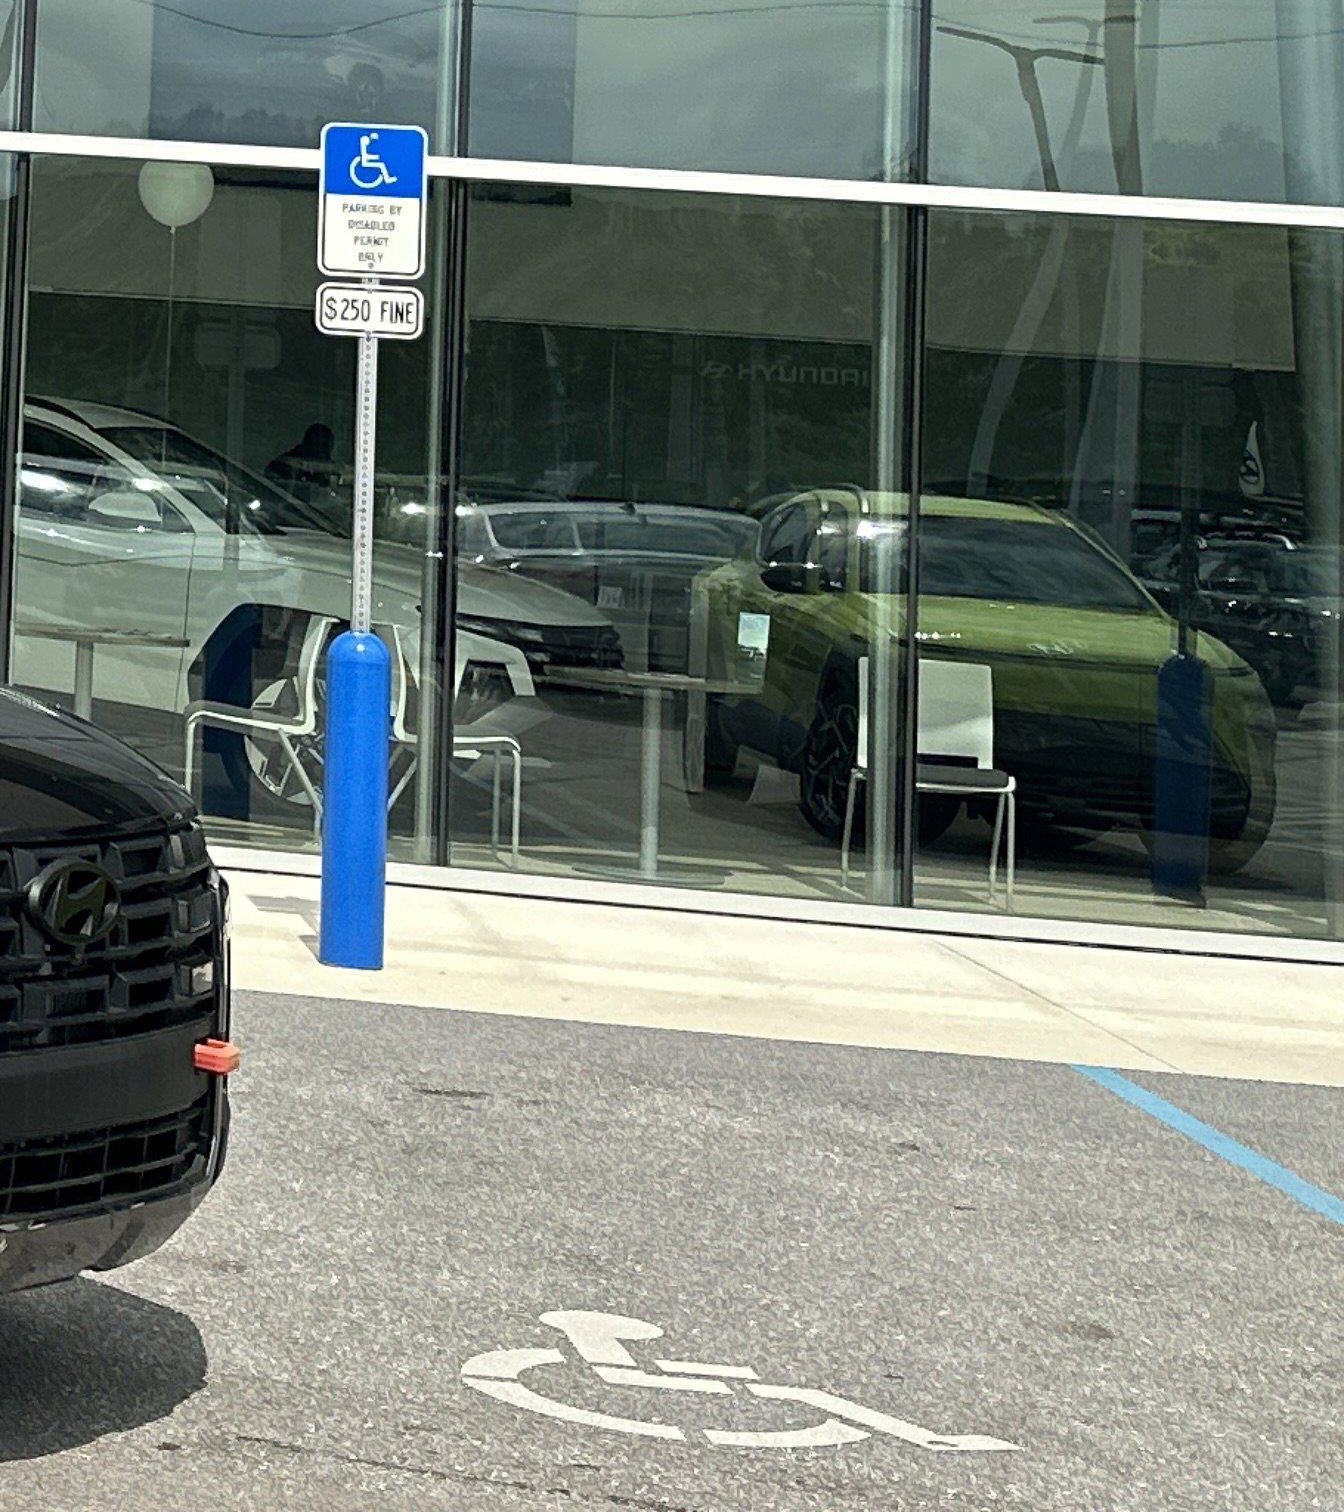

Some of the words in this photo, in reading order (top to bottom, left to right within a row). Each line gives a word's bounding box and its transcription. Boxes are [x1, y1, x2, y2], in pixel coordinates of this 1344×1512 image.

[342, 203, 385, 214] PARKING
[389, 204, 403, 216] BY
[347, 219, 396, 231] DISABLED
[353, 235, 389, 246] PERMIT
[325, 296, 371, 321] $250
[381, 300, 414, 324] FINE
[736, 362, 869, 387] HYUNDAI
